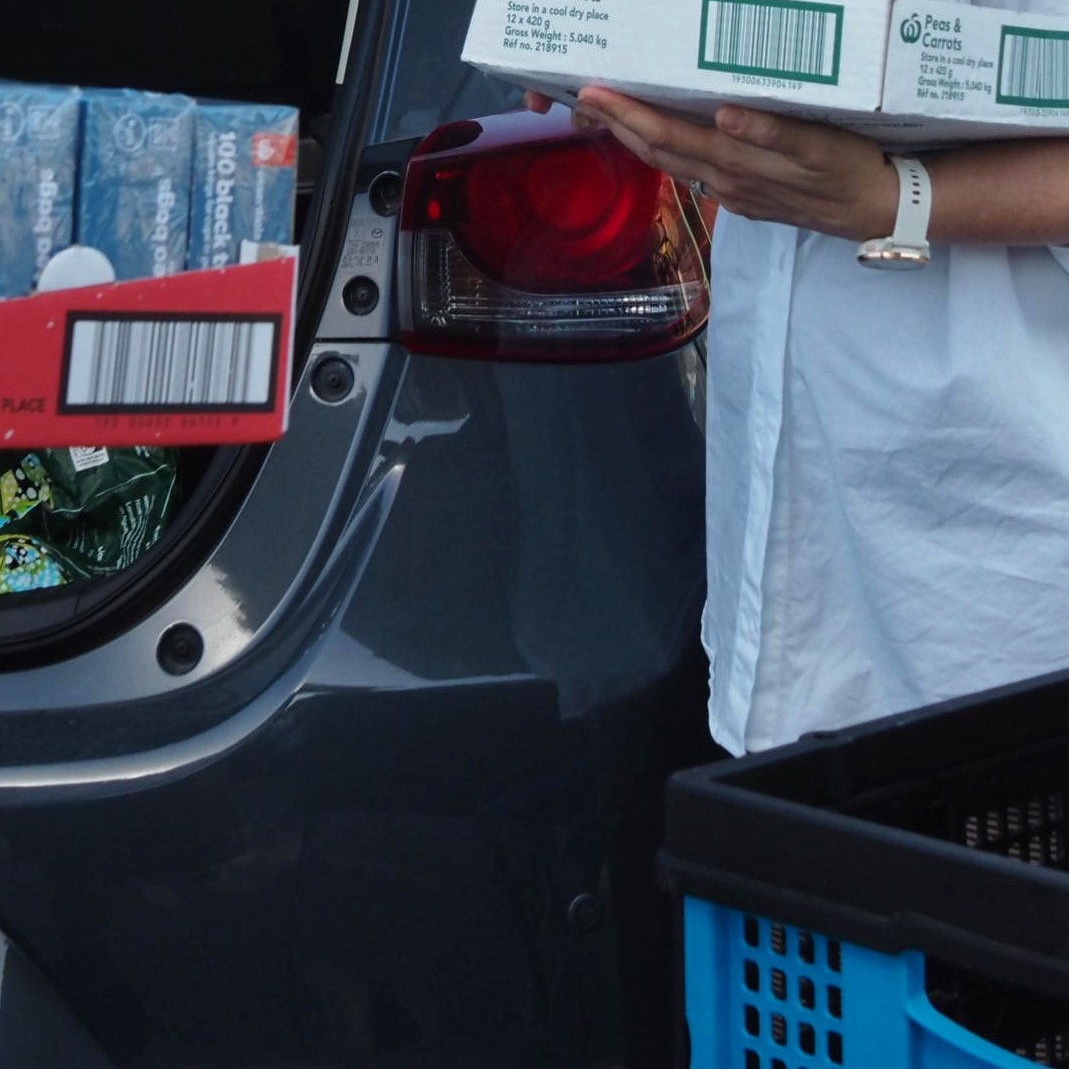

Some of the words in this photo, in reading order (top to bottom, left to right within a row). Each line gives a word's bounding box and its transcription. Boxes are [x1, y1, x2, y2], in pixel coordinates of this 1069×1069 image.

[507, 1, 530, 12] Store
[532, 3, 539, 13] in
[541, 6, 547, 14] a
[549, 6, 567, 16] cool
[569, 7, 584, 20] dry
[586, 9, 609, 21] place
[507, 14, 516, 24] 12
[526, 16, 542, 26] 420
[544, 19, 550, 29] g
[925, 14, 951, 32] Peas
[954, 18, 962, 33] &
[505, 26, 528, 37] Gross
[531, 28, 562, 42] Weight
[569, 33, 594, 44] 5.040
[596, 34, 607, 49] kg
[922, 32, 962, 51] Carrots
[520, 42, 533, 51] no.
[535, 41, 568, 54] 218915
[920, 64, 928, 74] 12
[921, 51, 939, 63] Store
[978, 58, 993, 69] place
[918, 76, 937, 87] Gross
[217, 131, 236, 175] 100
[33, 168, 58, 233] bags
[151, 178, 175, 242] bags
[213, 178, 235, 250] black
[154, 246, 167, 277] ea
[1, 397, 46, 414] PLACE
